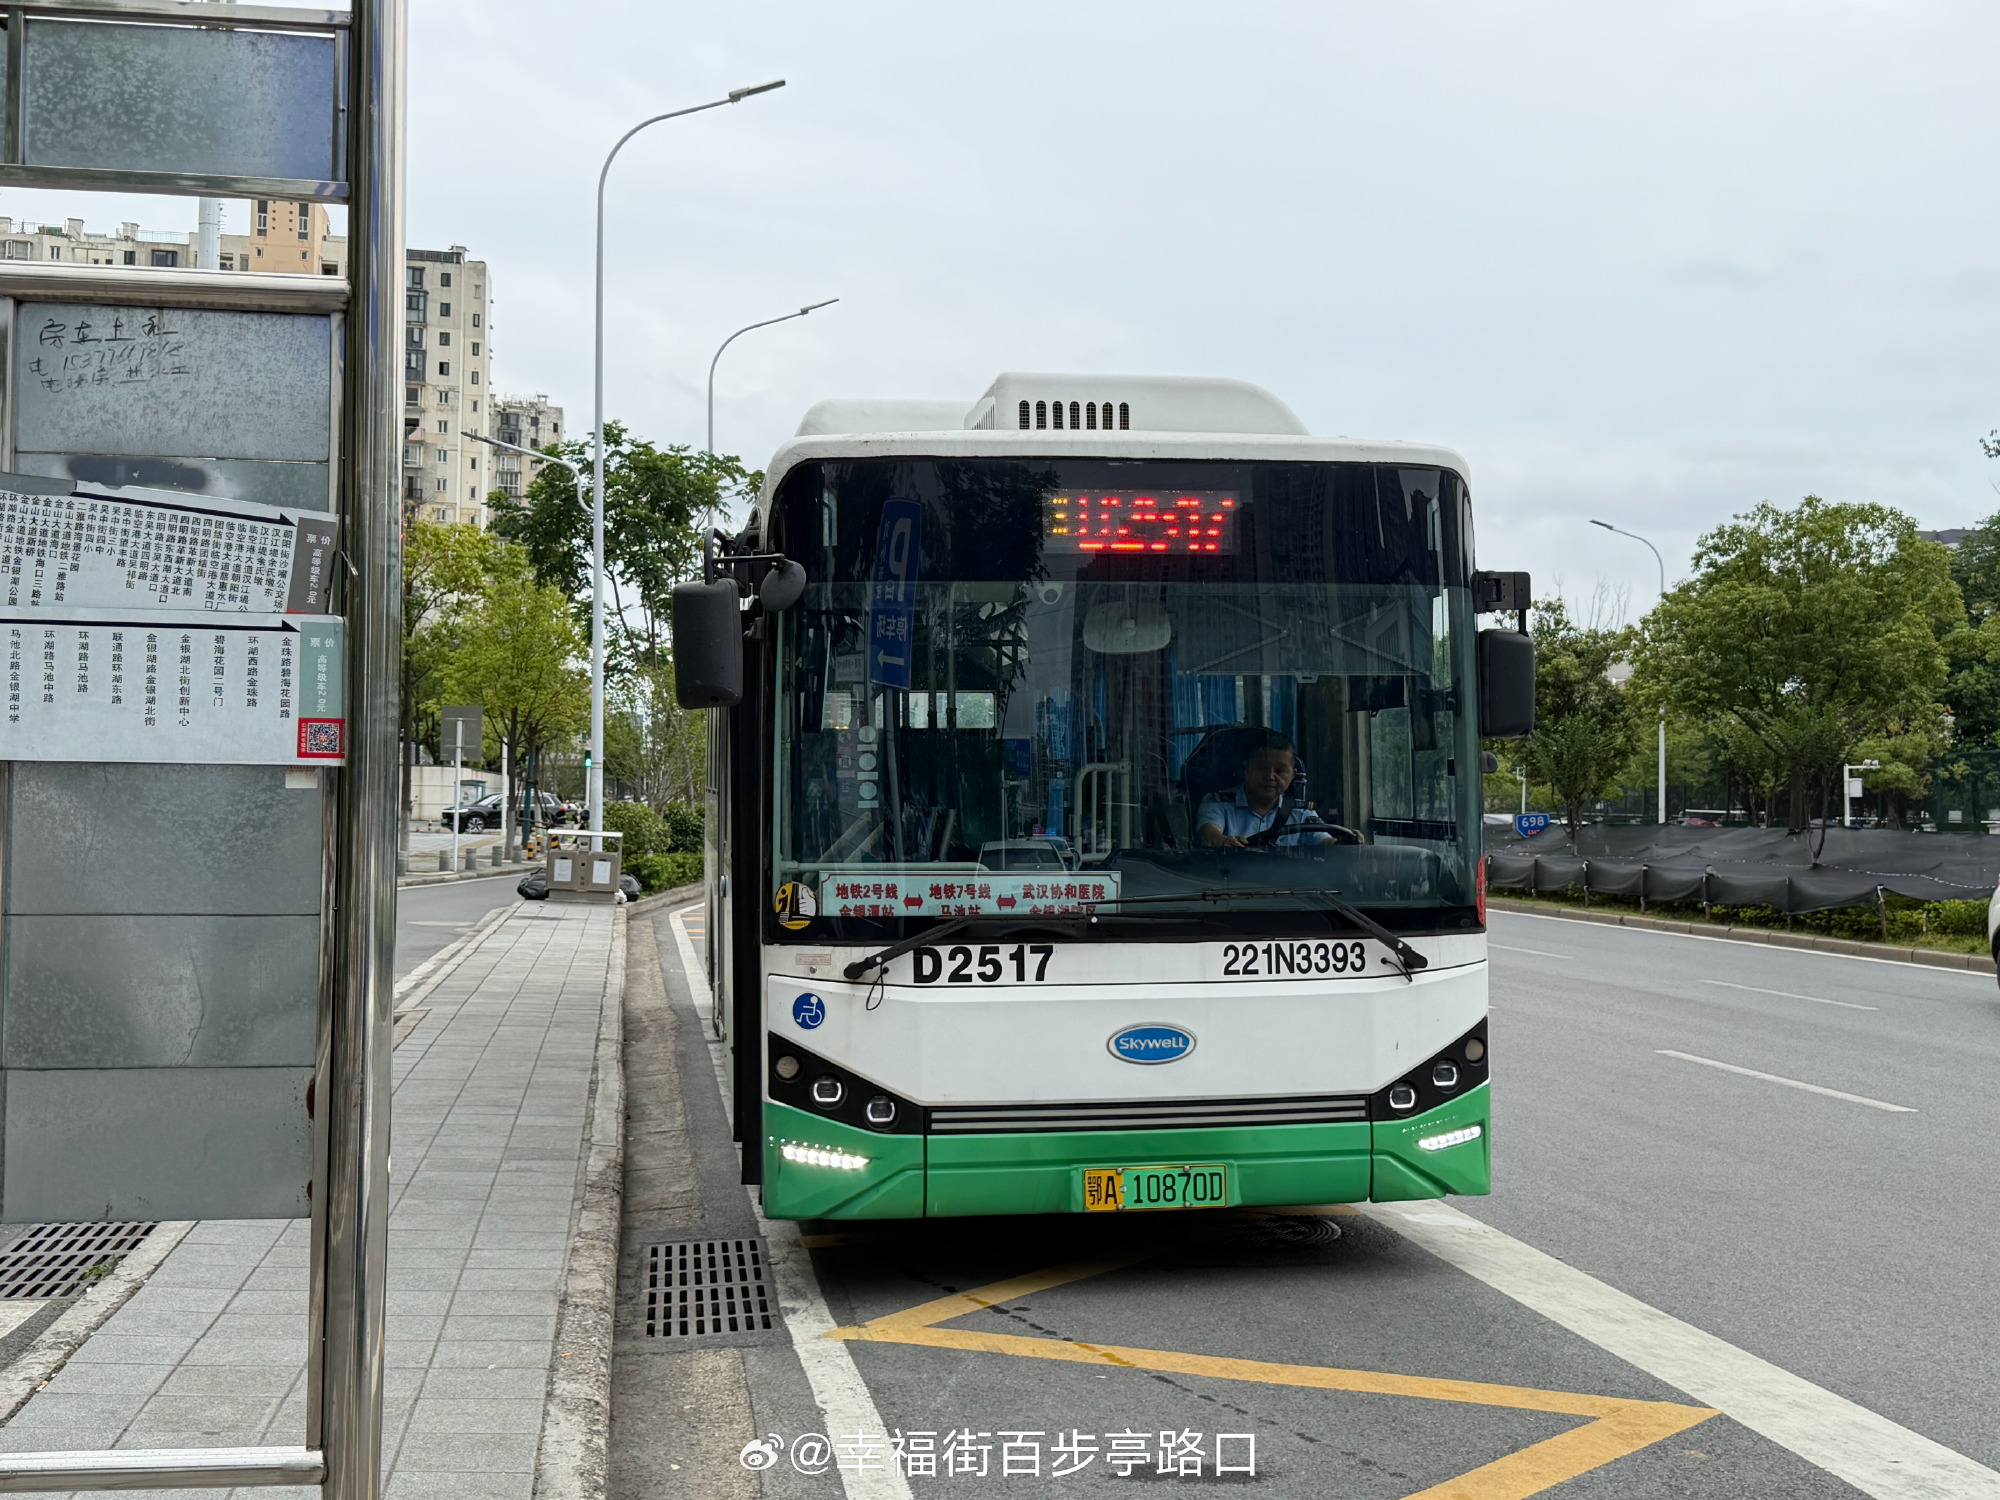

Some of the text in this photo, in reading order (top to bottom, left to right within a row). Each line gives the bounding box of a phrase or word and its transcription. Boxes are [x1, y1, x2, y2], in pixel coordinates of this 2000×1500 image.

[1, 493, 18, 574] 环湖路金山大道口
[8, 494, 30, 606] 金山大道地铁金银湖公园
[25, 495, 41, 557] 金山大道新桥
[49, 499, 64, 559] 金山大道海口
[54, 500, 75, 602] 金山大道地铁二雅路站
[83, 503, 98, 553] 吴中街四小
[95, 504, 110, 555] 吴中街四中
[106, 506, 121, 556] 吴中街三小
[116, 507, 132, 568] 吴中街望丰路
[126, 509, 144, 590] 临空港大道吴祁街
[138, 510, 155, 581] 东吴大道四明路
[149, 512, 166, 592] 四明路东吴大道口
[159, 513, 178, 603] 四明路东西湖大道口
[170, 515, 190, 595] 四明路革新大道北
[183, 517, 201, 597] 四明路革新大道南
[196, 518, 212, 578] 四明路团结街
[253, 526, 270, 586] 汉江堤余氏墩
[205, 520, 224, 609] 团结街临空港大道口
[215, 521, 235, 610] 临空港大道慈惠水厂
[228, 523, 247, 603] 临空港大道朝阳街
[264, 528, 281, 598] 汉江堤余氏墩东
[273, 529, 293, 613] 朝阳街沙嘴公交场
[306, 548, 323, 605] 高等级车2.0元
[9, 629, 21, 723] 马池北路金银湖中学
[43, 630, 55, 703] 环湖路马池中路
[77, 631, 89, 693] 环湖路马池路
[111, 632, 124, 704] 联通路环湖东路
[213, 635, 225, 707] 碧海花园二号门
[246, 636, 259, 708] 环湖西路金珠路
[280, 637, 292, 719] 金珠路碧海花园路
[310, 637, 336, 649] 票价
[144, 633, 157, 727] 金银湖路金银湖北街
[178, 634, 191, 727] 金银湖北街创新中心
[316, 655, 327, 713] 高等级车2.0元
[1522, 816, 1545, 828] 698
[835, 883, 1105, 900] 地铁2号线 地铁7号线 武汉协和医院
[913, 945, 1053, 984] D2517
[1223, 941, 1366, 976] 221N3393
[1087, 1175, 1118, 1206] 鄂A
